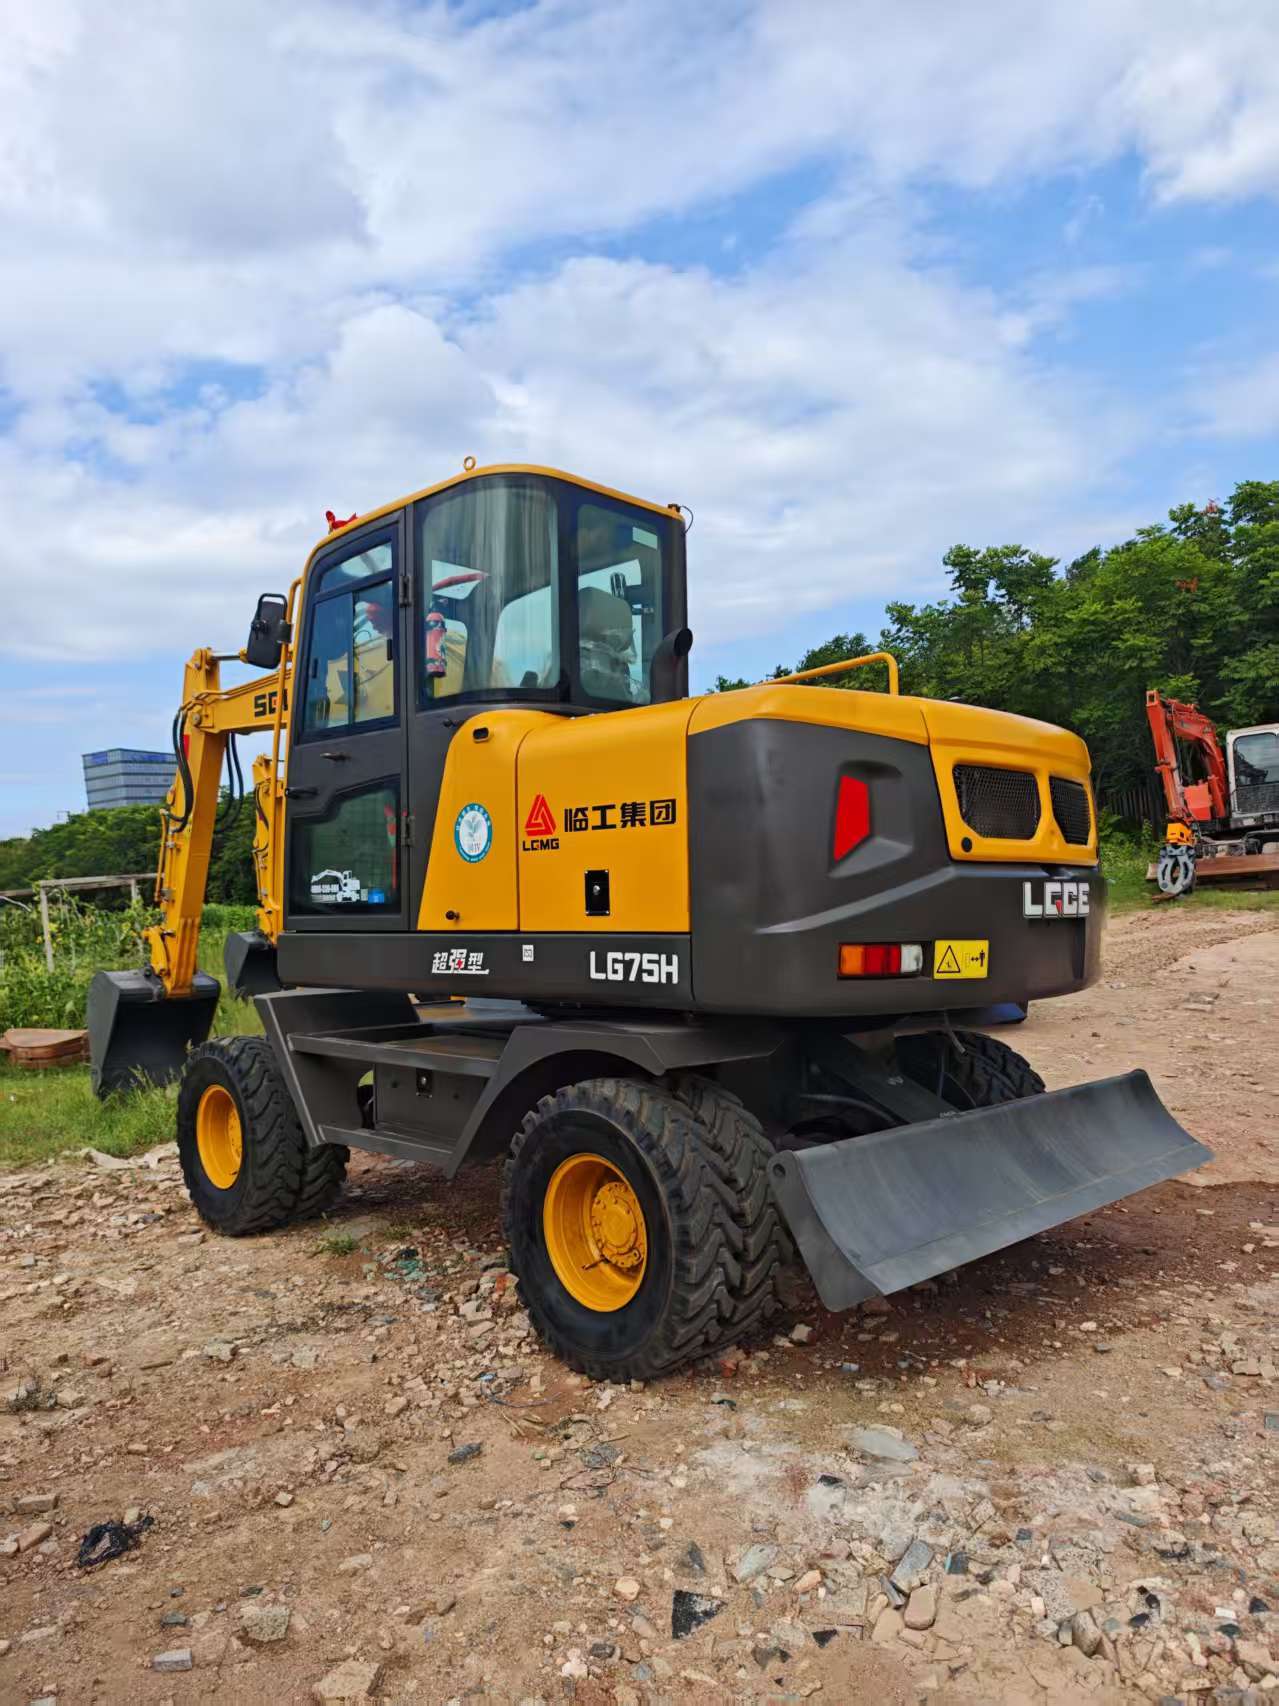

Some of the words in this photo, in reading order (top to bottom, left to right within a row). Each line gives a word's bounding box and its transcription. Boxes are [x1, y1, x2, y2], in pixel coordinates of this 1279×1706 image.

[564, 799, 676, 832] 临工集团
[432, 949, 489, 975] 超强型
[590, 951, 678, 984] LG75H
